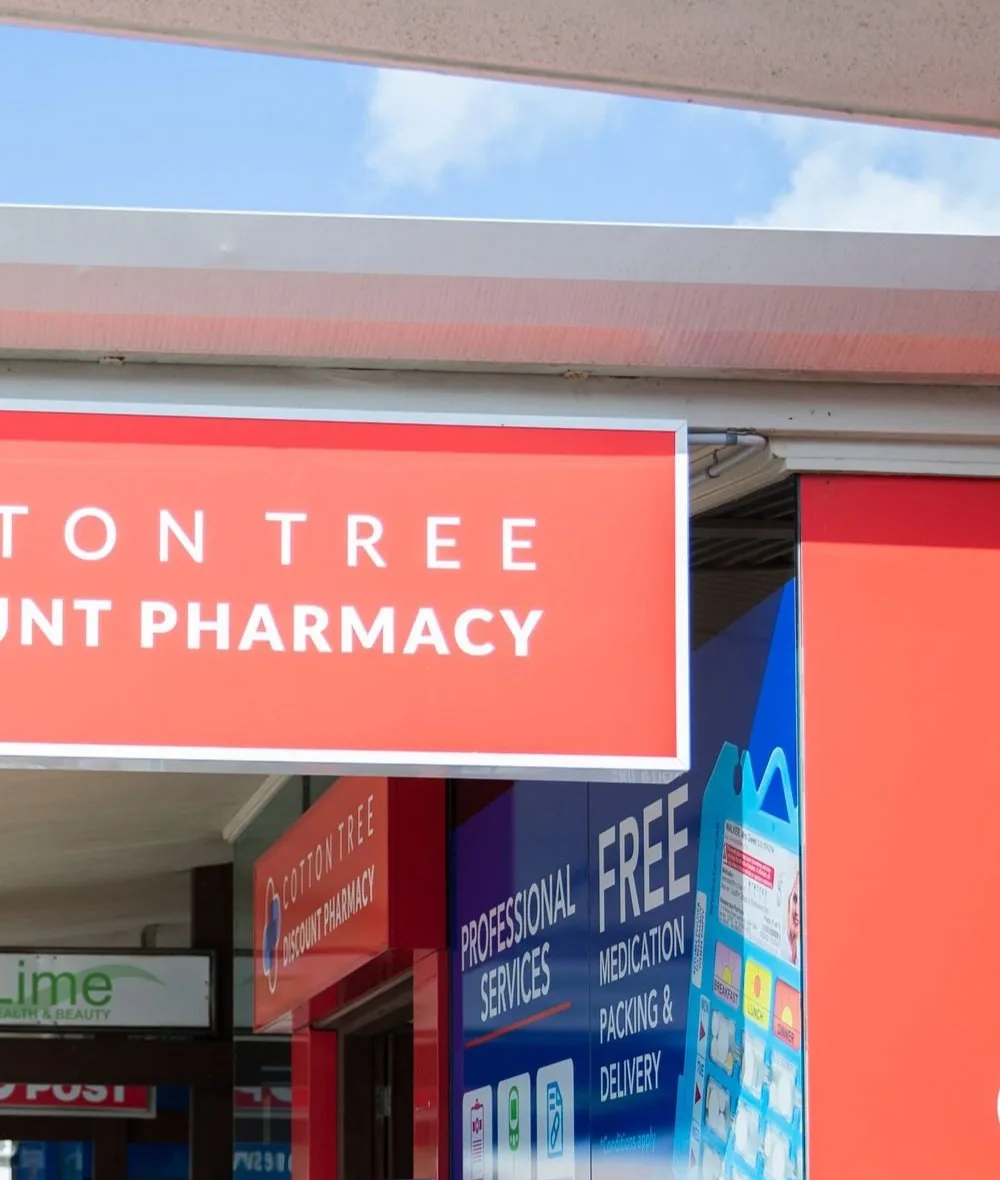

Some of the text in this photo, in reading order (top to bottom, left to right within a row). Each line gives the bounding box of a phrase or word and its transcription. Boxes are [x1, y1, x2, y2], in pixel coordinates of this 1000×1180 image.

[265, 512, 537, 571] TREE
[140, 601, 544, 657] PHARMACY
[282, 794, 374, 909] COTTON TREE
[599, 783, 691, 933] FREE
[283, 865, 375, 967] DISCOUNT PHARMACY
[461, 864, 576, 971] PROFESSIONAL
[600, 916, 685, 986] MEDICATION
[480, 942, 550, 1022] SERVICES
[713, 979, 738, 1003] BREAKFAST
[43, 1009, 51, 1019] &
[56, 1009, 111, 1020] BEAUTY
[600, 984, 673, 1044] PACKING &
[746, 1005, 764, 1021] LUNCH
[776, 1021, 795, 1044] DINNER
[600, 1050, 662, 1102] DELIVERY
